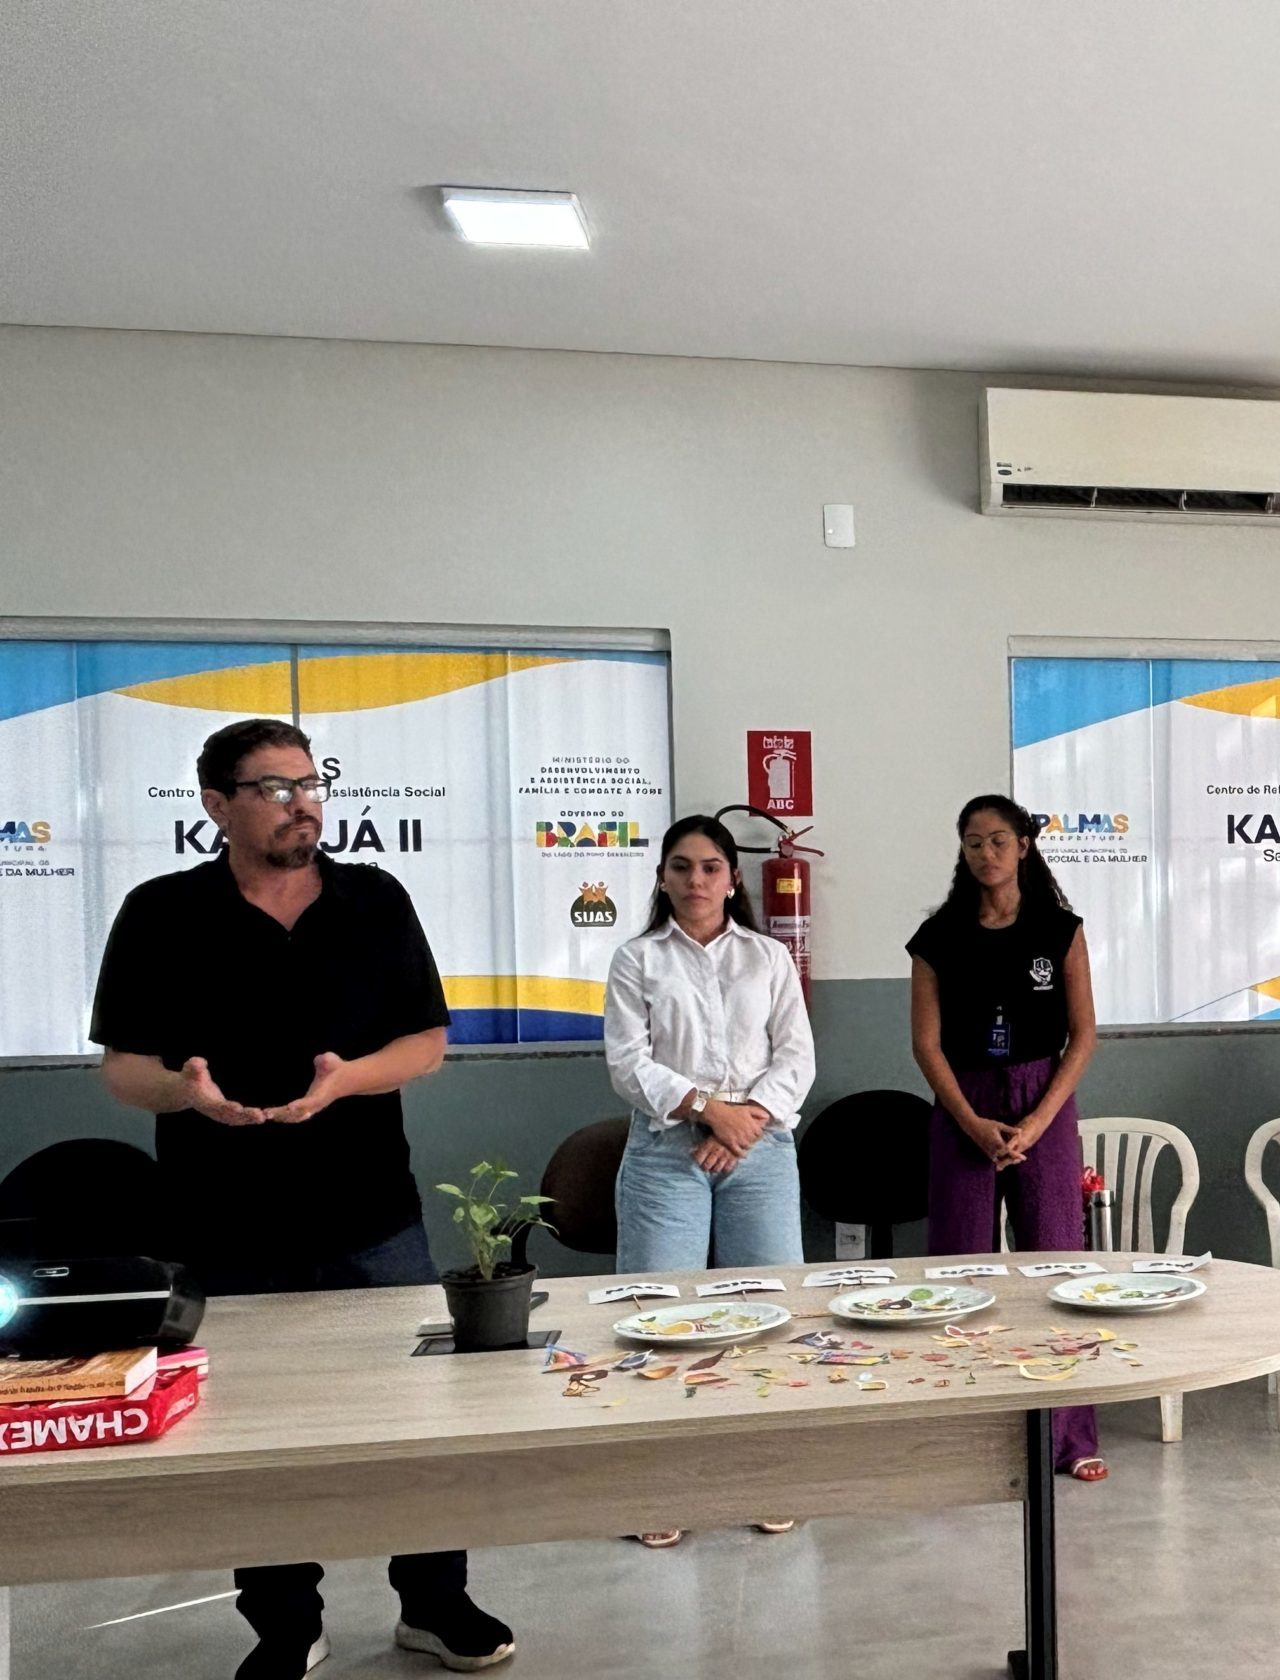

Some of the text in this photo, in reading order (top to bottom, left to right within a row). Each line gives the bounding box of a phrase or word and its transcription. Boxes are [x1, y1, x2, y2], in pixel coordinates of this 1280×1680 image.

[148, 786, 446, 798] Centro ssistência Social
[1206, 785, 1243, 795] Centro
[766, 799, 795, 810] ABC
[1031, 813, 1129, 833] PALMAS
[399, 819, 422, 852] II
[536, 821, 649, 848] BRASIL
[1093, 855, 1106, 863] DA
[25, 868, 75, 876] MULHER
[574, 911, 614, 923] SUAS
